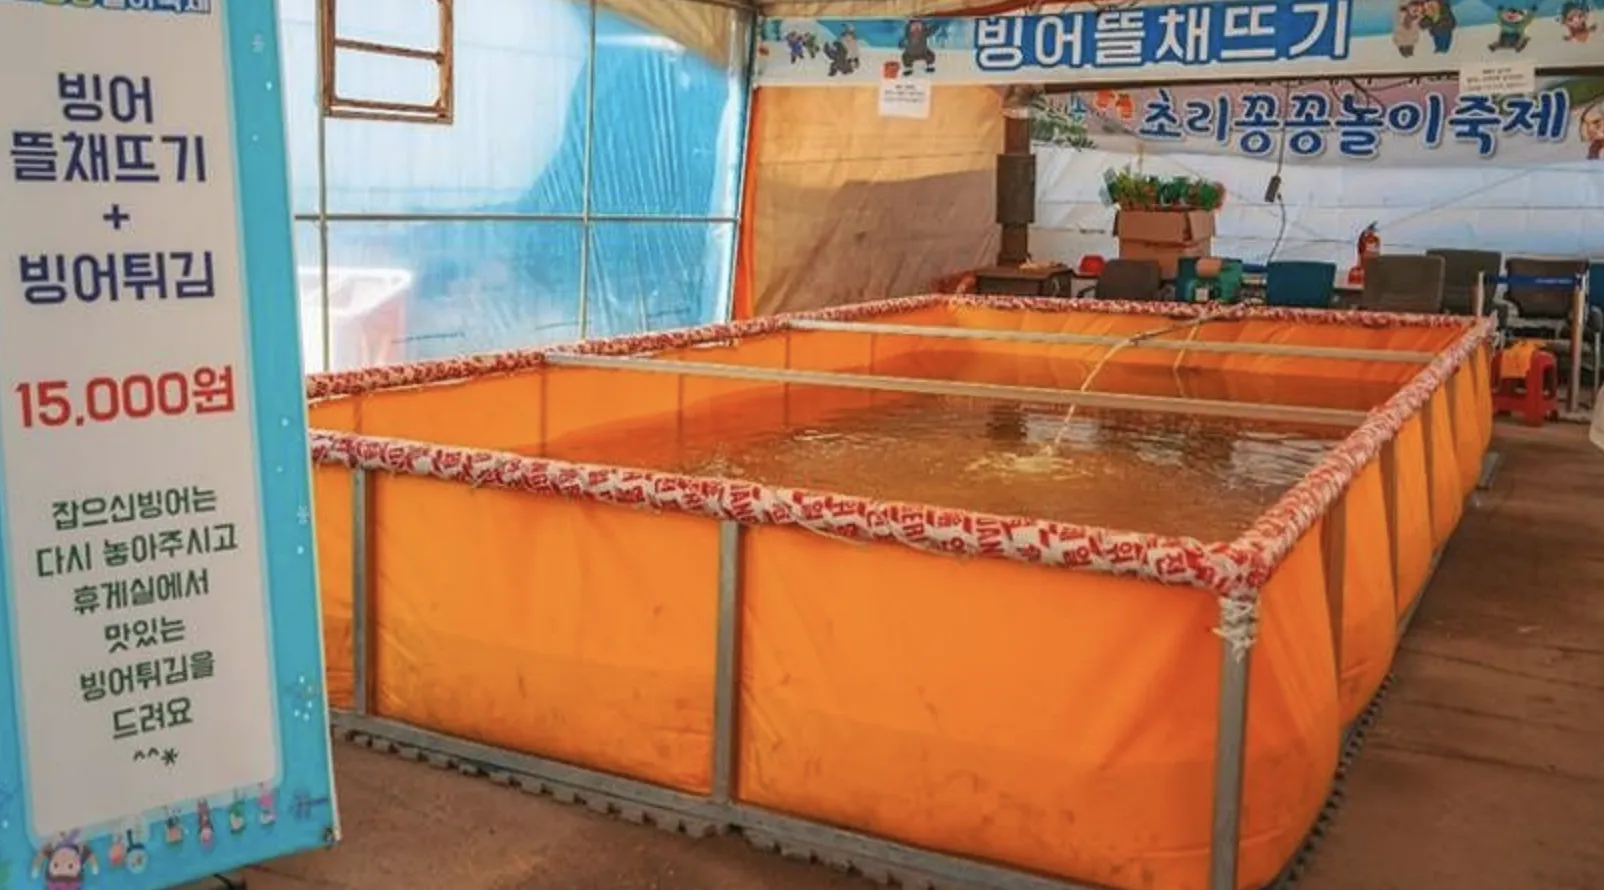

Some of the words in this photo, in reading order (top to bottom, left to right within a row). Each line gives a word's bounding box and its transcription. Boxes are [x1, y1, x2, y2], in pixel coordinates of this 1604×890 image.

[977, 2, 1346, 67] 빙어뜰채뜨기
[58, 72, 154, 124] 빙어
[1138, 89, 1569, 154] 초리꽁꽁놀이축제
[10, 131, 206, 183] 뜰채뜨기
[19, 250, 215, 305] 빙어튀김
[52, 486, 217, 531] 잡으신빙어는
[36, 542, 92, 578] 다시
[102, 523, 239, 568] 놓아주시고
[72, 568, 210, 616] 휴게실에서
[104, 616, 186, 654] 맛있는
[79, 650, 216, 702] 빙어튀김을
[112, 696, 193, 740] 드려요
